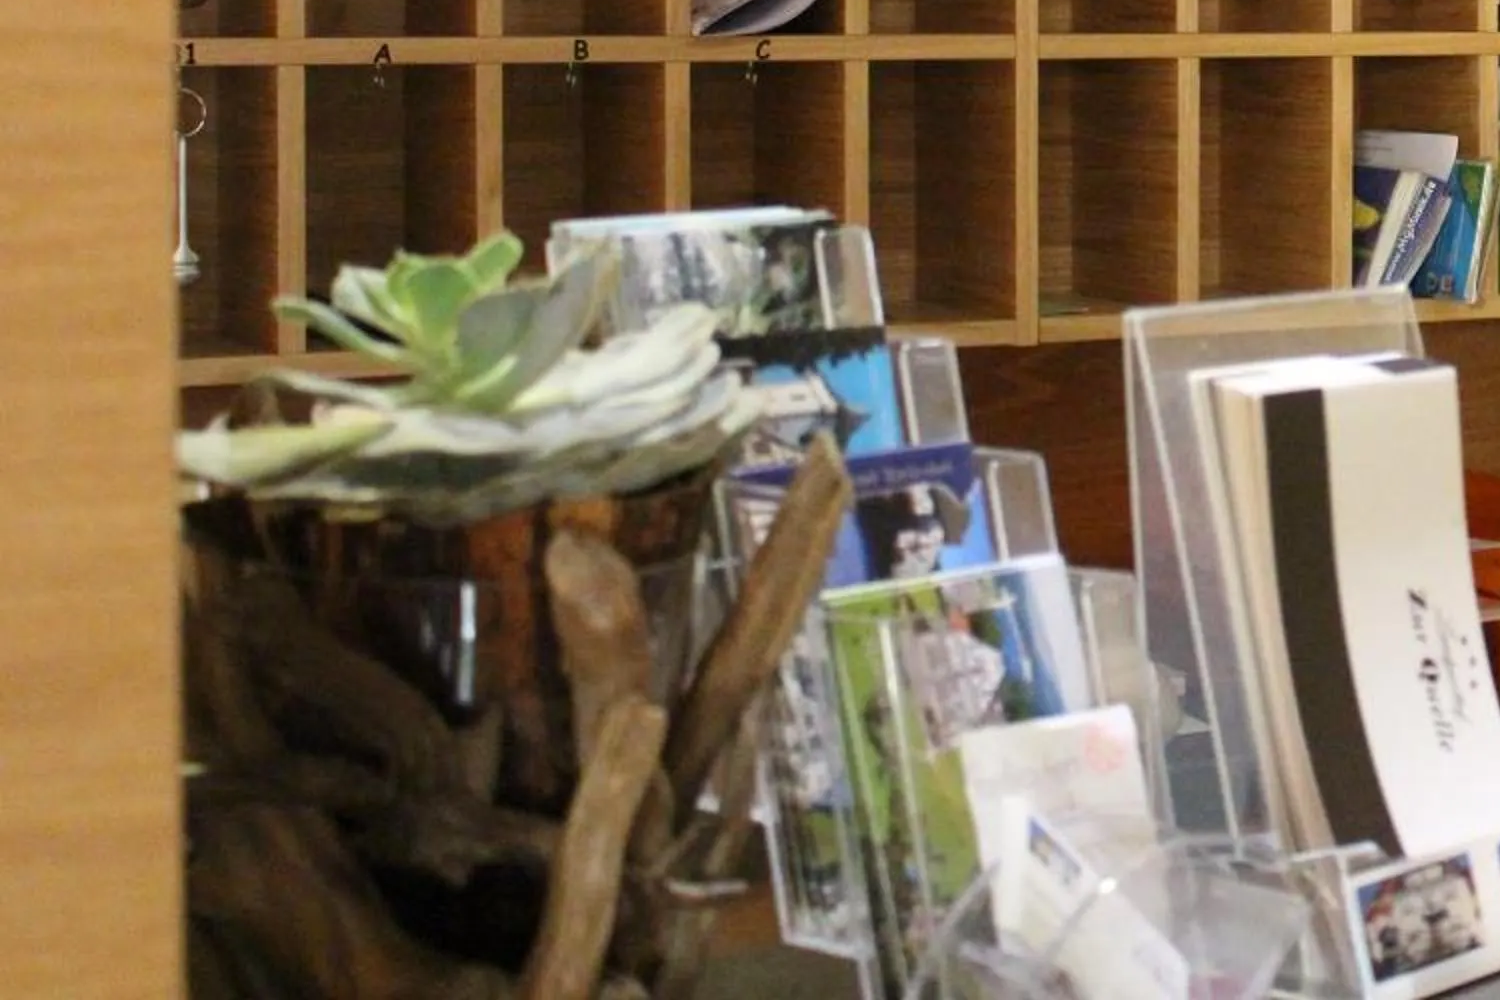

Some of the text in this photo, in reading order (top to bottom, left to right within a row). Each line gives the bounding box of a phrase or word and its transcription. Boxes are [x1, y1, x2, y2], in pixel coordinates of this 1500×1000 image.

[373, 43, 393, 64] A
[573, 38, 590, 61] B
[754, 38, 773, 60] C
